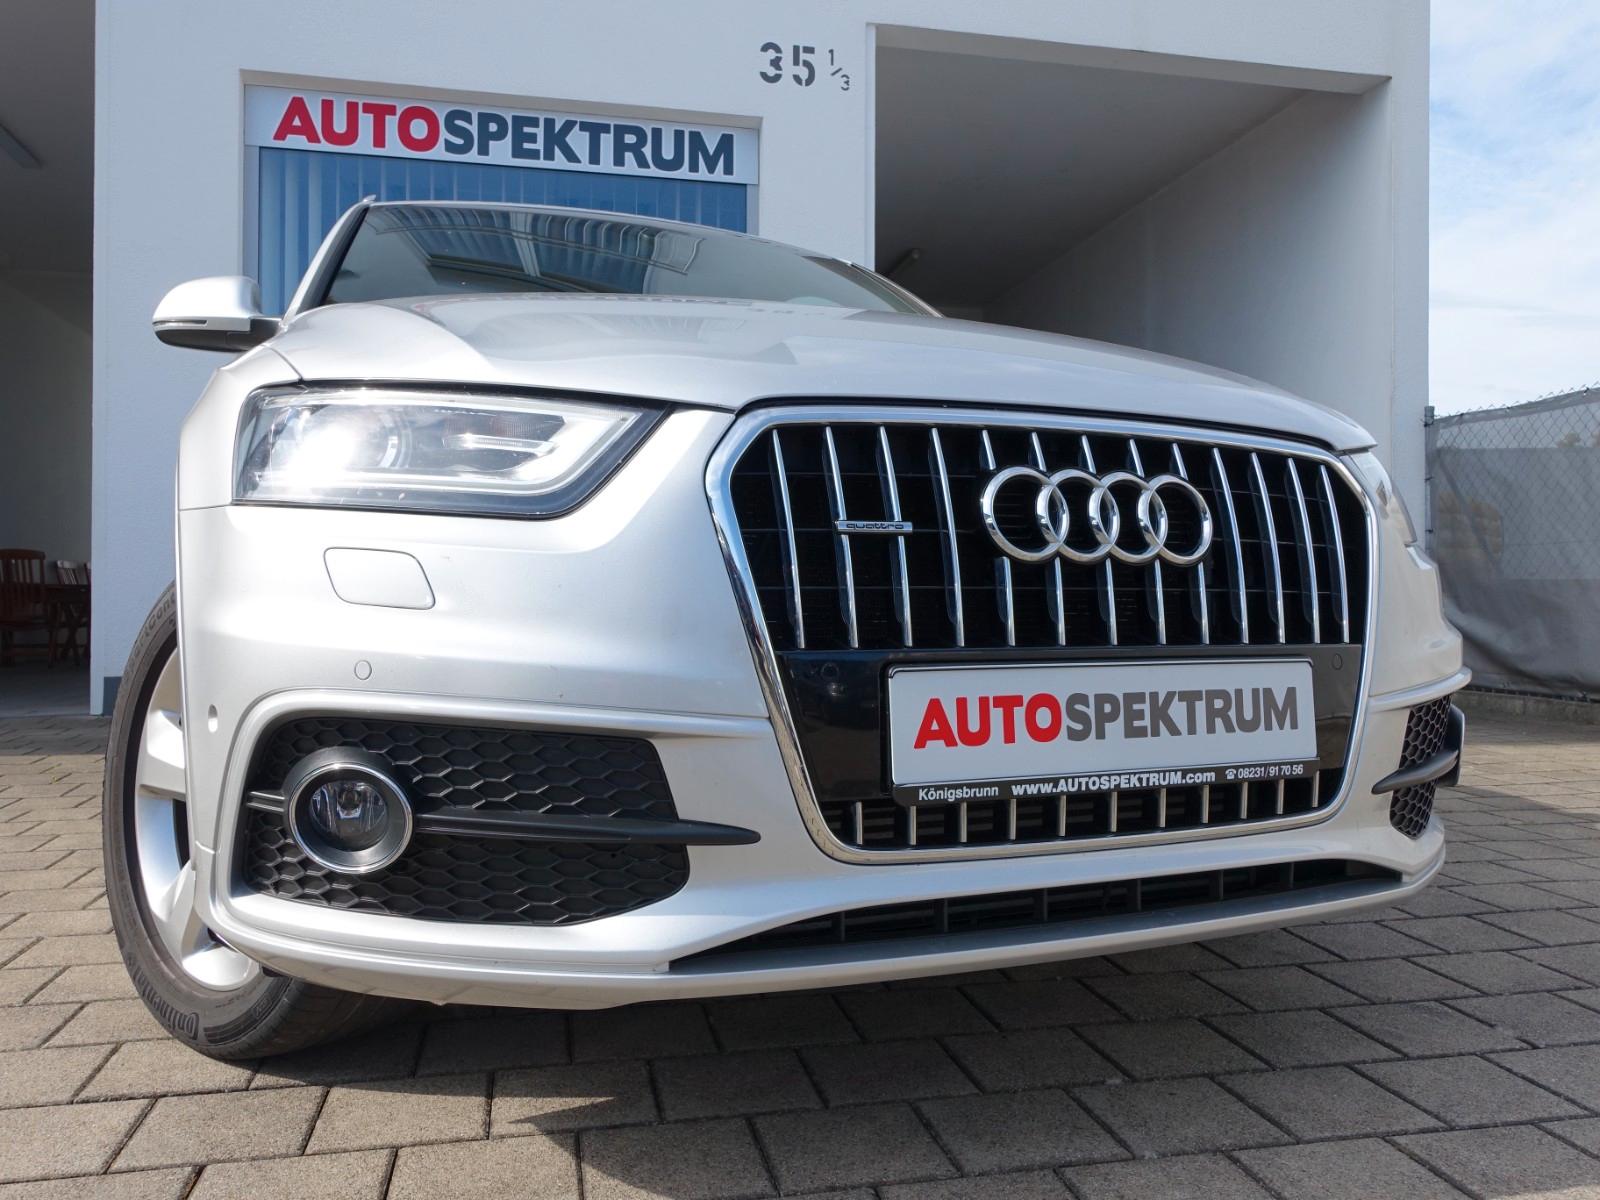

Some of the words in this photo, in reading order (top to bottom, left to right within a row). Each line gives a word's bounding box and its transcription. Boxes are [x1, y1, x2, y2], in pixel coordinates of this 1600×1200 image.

[760, 42, 816, 87] 35
[273, 95, 734, 176] AUTOSPEKTRUM
[846, 522, 904, 530] quattro
[913, 686, 1299, 750] AUTOSPEKTRUM
[918, 786, 999, 802] Königsbrunn
[1011, 770, 1216, 796] www.AUTOSPEKTRUM.com
